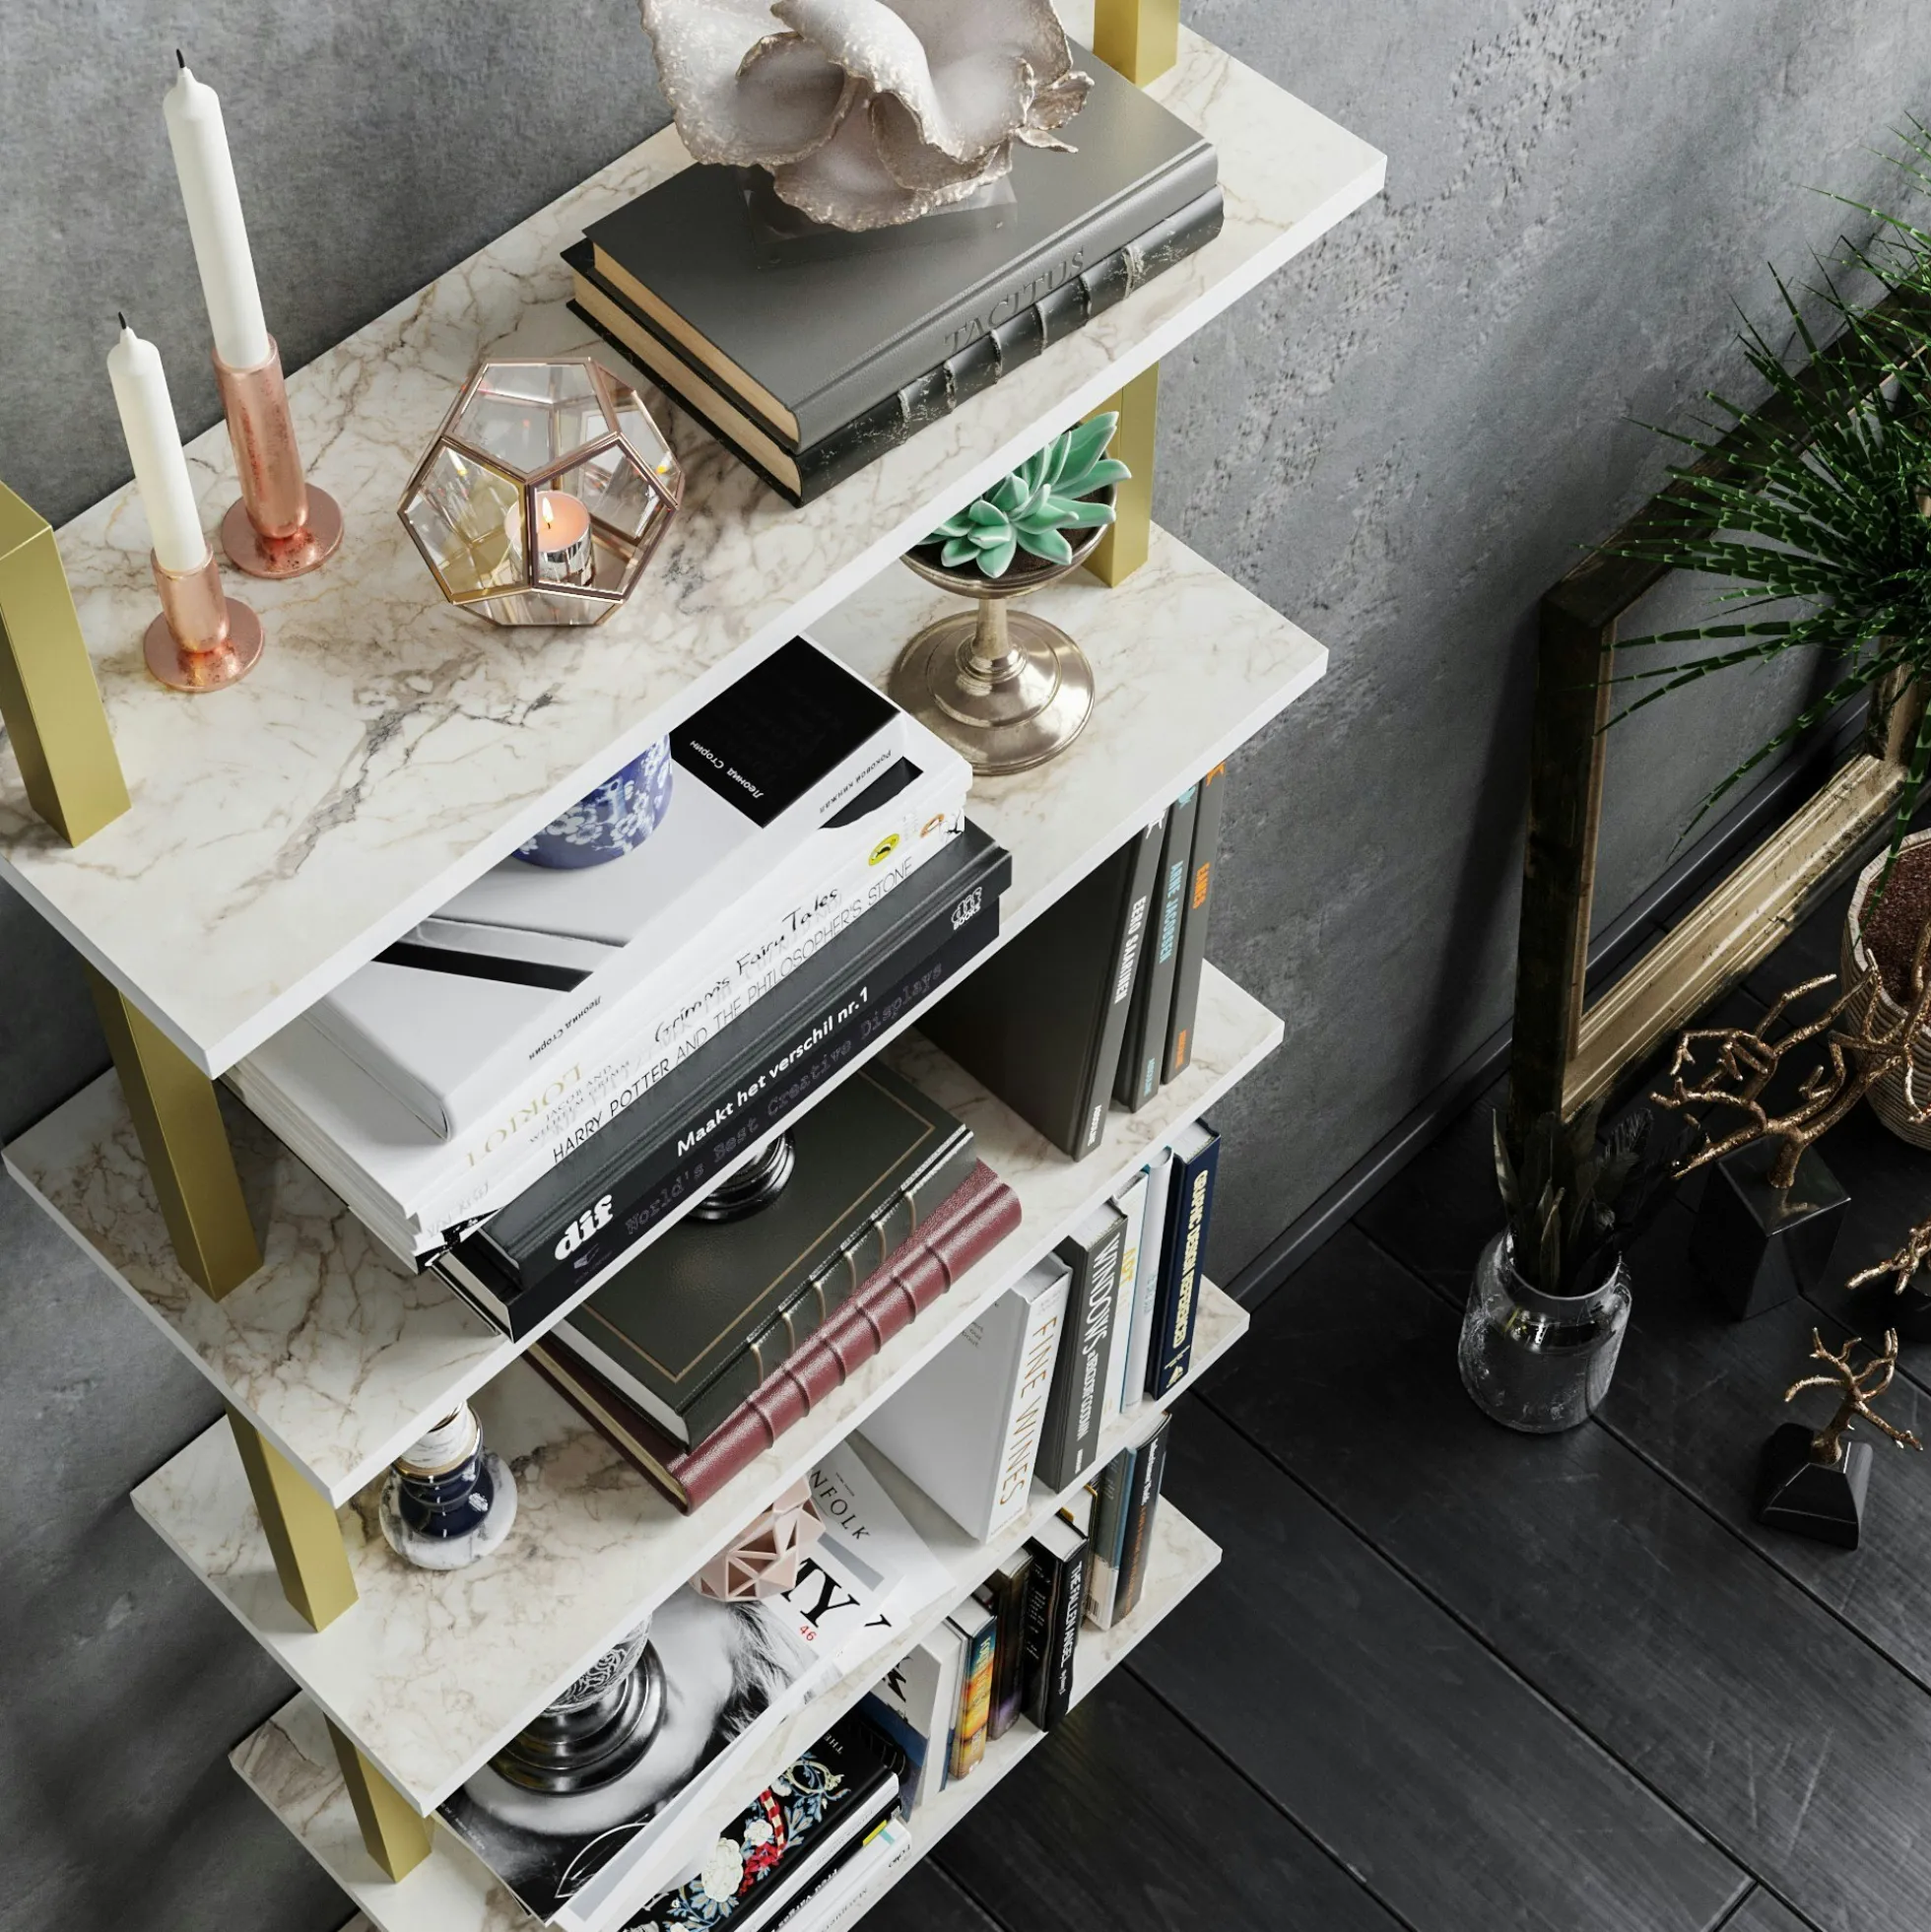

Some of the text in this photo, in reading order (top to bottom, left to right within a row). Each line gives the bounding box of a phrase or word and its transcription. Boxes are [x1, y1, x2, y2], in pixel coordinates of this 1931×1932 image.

[944, 245, 1084, 355] TACITUS
[690, 740, 765, 799] Леонид Сторин
[953, 903, 982, 931] BOOKS
[1159, 860, 1184, 965] ARNE JACOBSEN
[654, 975, 730, 1043] Grimm's
[782, 889, 838, 933] Tales
[1113, 894, 1148, 1005] EERO SAARINEN
[528, 996, 601, 1060] Леонид Сторин
[553, 856, 913, 1163] HARRY POTTER AND THE PHILOSOPHER'S STONE
[625, 963, 943, 1234] World's Best Creative Displays
[677, 986, 869, 1158] Maakt het verschil nr. 1
[555, 1194, 613, 1260] dif
[1188, 1169, 1209, 1231] GRAPHIC
[1182, 1225, 1201, 1278] DESIGN
[1082, 1232, 1121, 1355] WINDOWS
[1172, 1268, 1195, 1349] REFERENCED
[1020, 1315, 1058, 1400] FINE
[999, 1393, 1044, 1505] WINES
[1064, 1582, 1082, 1635] FALLEN
[1069, 1559, 1084, 1592] THE
[799, 1624, 818, 1642] 46
[1059, 1627, 1076, 1669] ANGEL
[824, 1733, 844, 1756] THE
